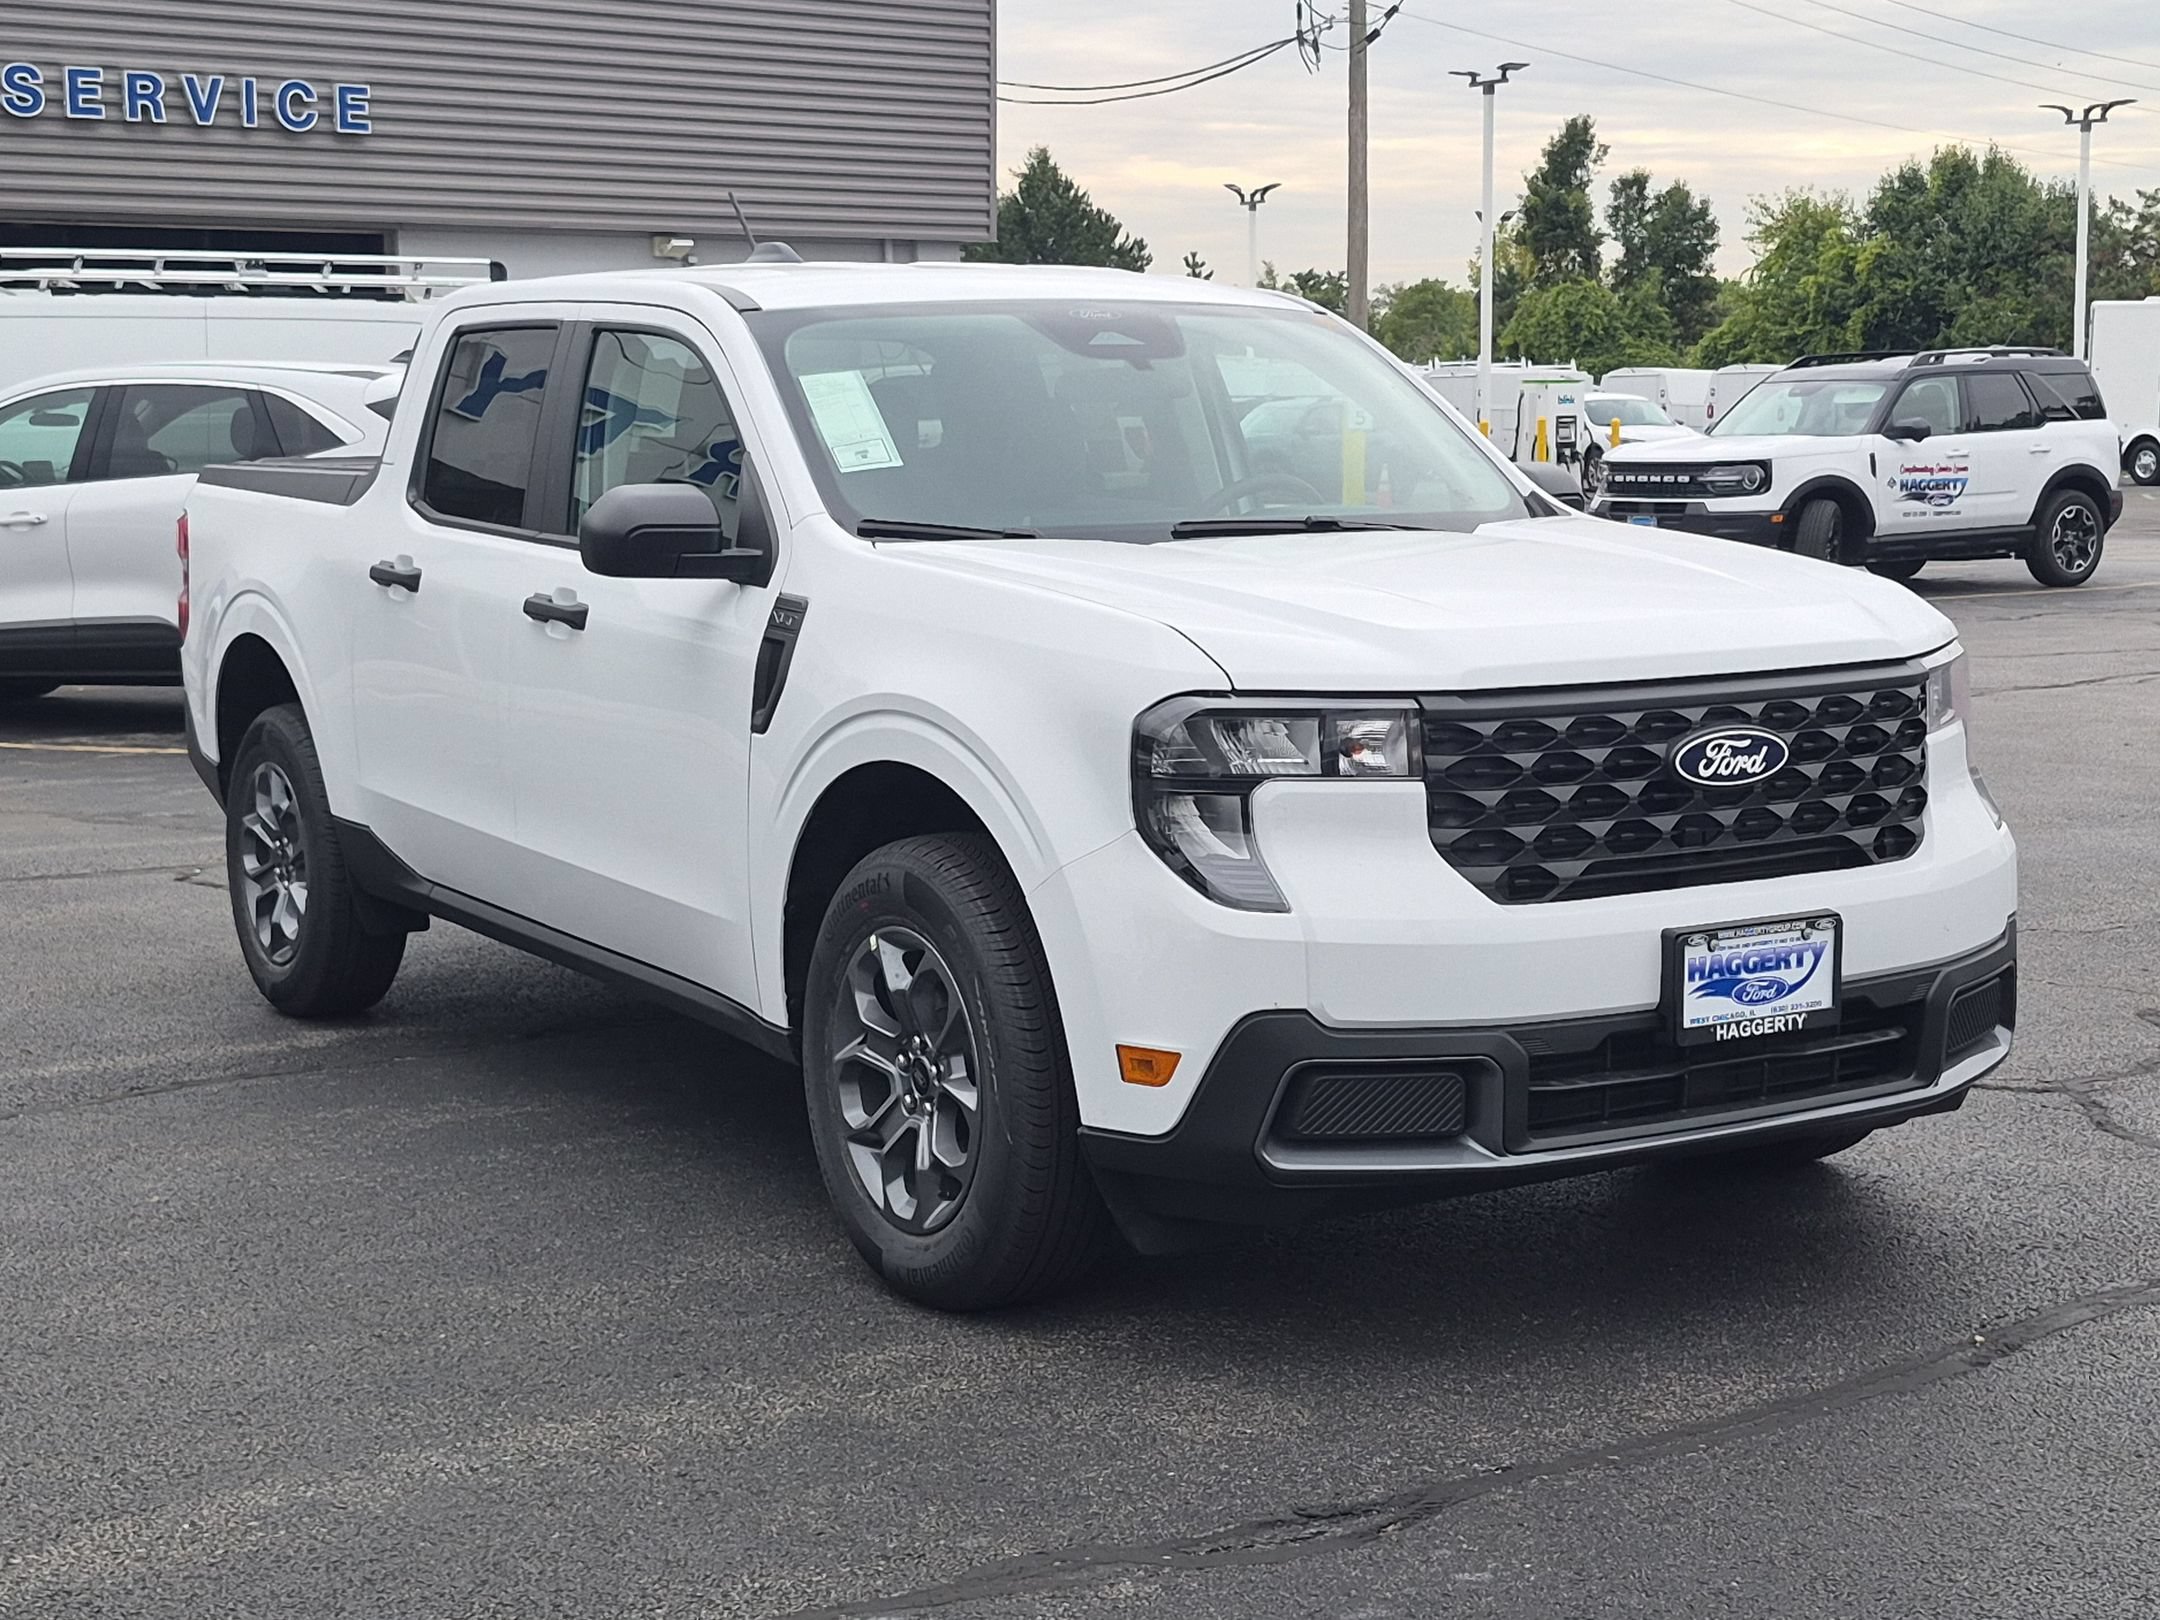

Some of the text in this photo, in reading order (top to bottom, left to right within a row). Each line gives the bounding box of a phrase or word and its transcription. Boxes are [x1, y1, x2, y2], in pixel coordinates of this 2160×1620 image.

[1, 62, 372, 134] SERVICE
[1613, 475, 1690, 483] BRONCO
[1899, 477, 1969, 493] HAGGERTY
[1698, 739, 1768, 778] Ford
[823, 872, 882, 942] Continental
[1688, 941, 1828, 982] HAGGERTY
[1742, 981, 1777, 1001] Ford
[1690, 1016, 1709, 1025] WEST
[1715, 1013, 1807, 1042] HAGGERTY
